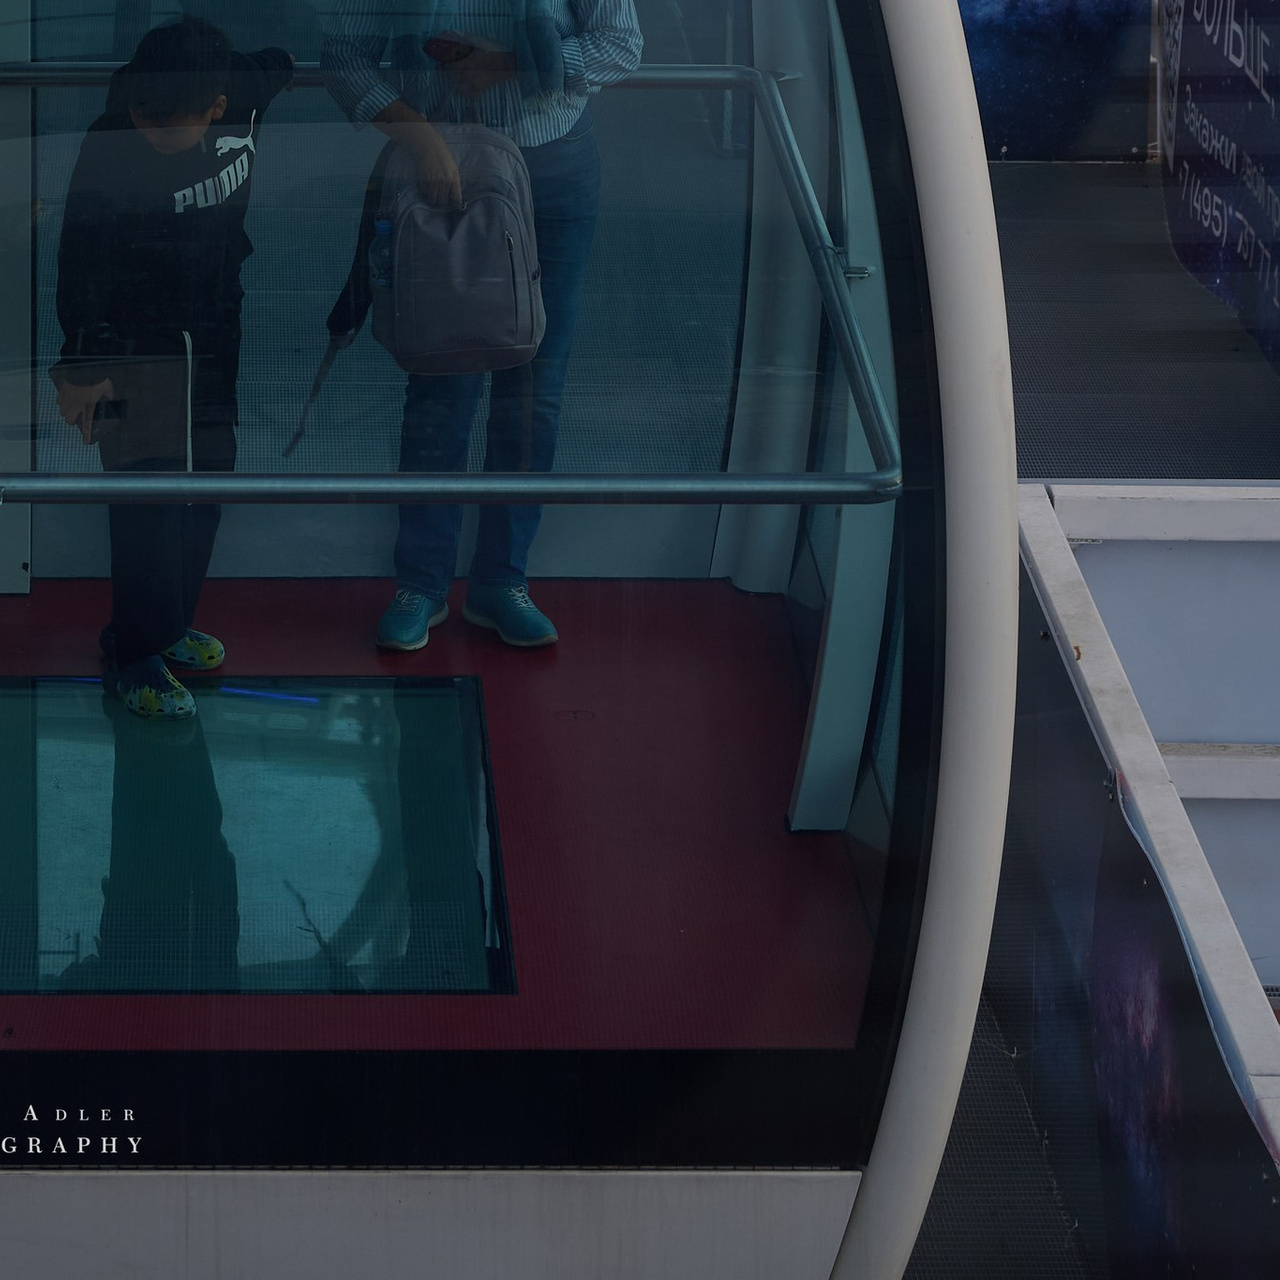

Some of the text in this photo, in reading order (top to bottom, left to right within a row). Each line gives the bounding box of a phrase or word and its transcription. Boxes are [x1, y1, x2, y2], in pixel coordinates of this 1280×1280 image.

[1183, 84, 1237, 174] Закажи
[173, 151, 249, 214] PUMA
[1189, 171, 1228, 248] (495)
